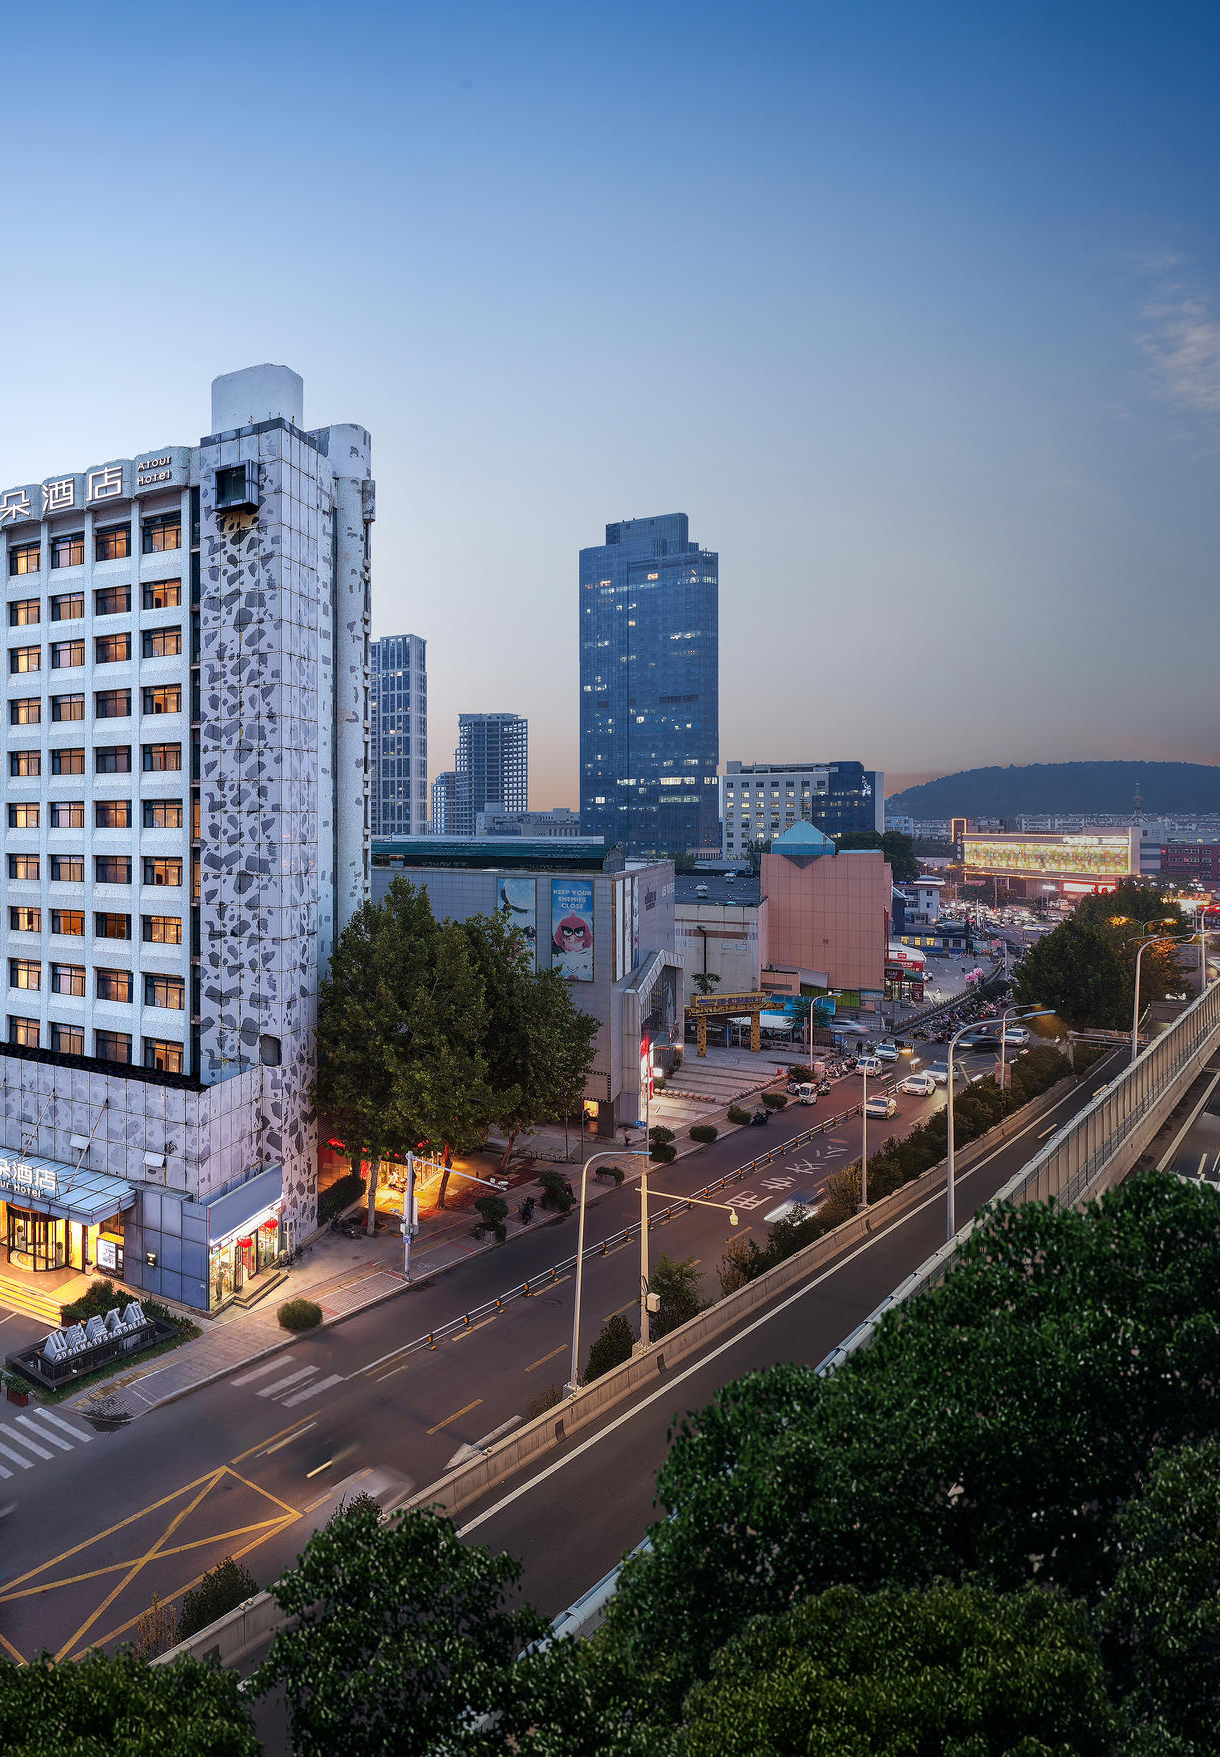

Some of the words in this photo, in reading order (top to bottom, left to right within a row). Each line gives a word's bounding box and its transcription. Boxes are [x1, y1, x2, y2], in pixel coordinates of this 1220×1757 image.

[137, 455, 172, 472] Atour
[136, 469, 172, 486] Hotel
[13, 1184, 42, 1198] Hotel
[103, 1329, 123, 1342] STAR
[124, 1317, 148, 1334] DREAM
